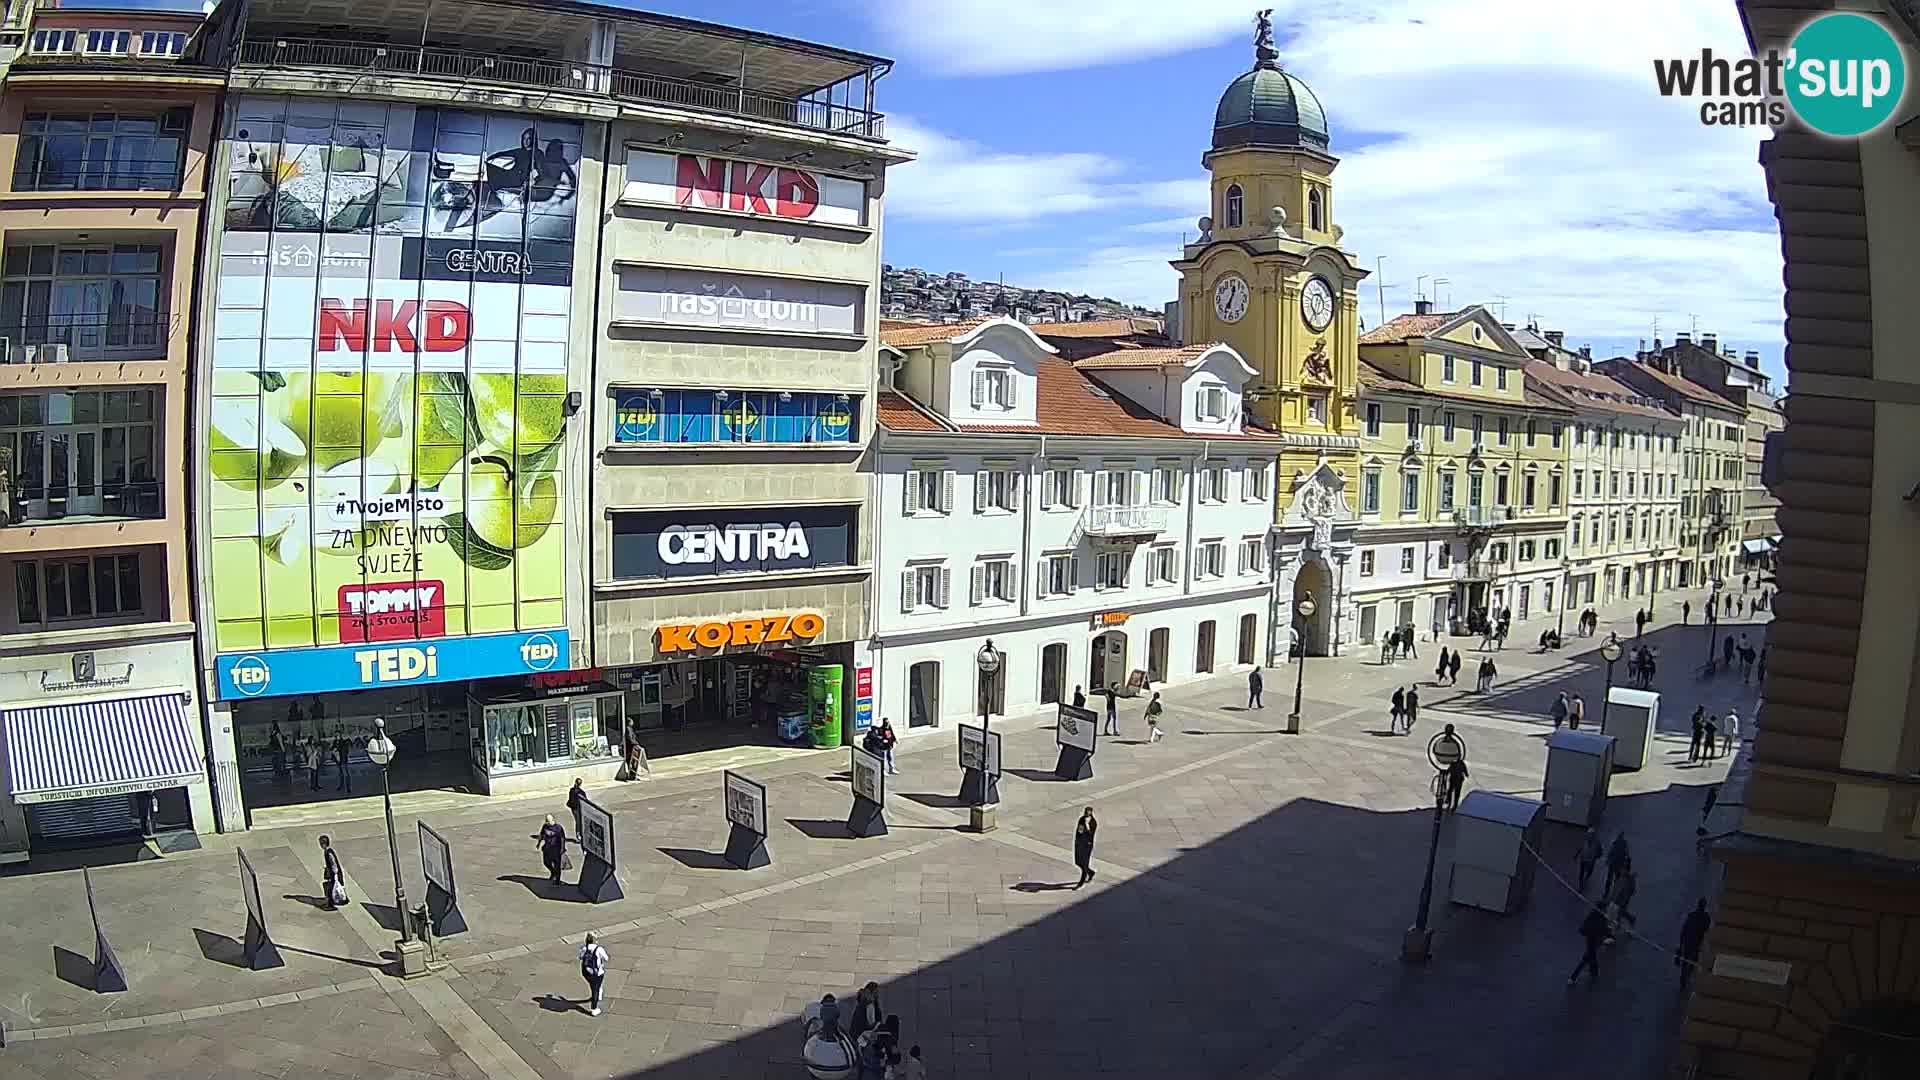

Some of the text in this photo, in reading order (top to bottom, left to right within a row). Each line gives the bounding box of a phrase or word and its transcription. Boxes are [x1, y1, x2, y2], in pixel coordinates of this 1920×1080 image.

[675, 155, 820, 219] NKD
[446, 249, 533, 275] CENTRA
[752, 288, 816, 323] dom
[317, 297, 473, 353] NKD
[331, 524, 448, 549] ZA DNEVNO
[658, 521, 810, 565] CENTRA
[357, 547, 424, 576] SVJEŽE
[346, 587, 437, 616] TOMMY
[658, 614, 825, 653] KORZO
[355, 645, 438, 684] TEDi
[520, 643, 558, 661] TEDi
[230, 666, 270, 685] TEDi
[146, 778, 179, 790] CENTAR
